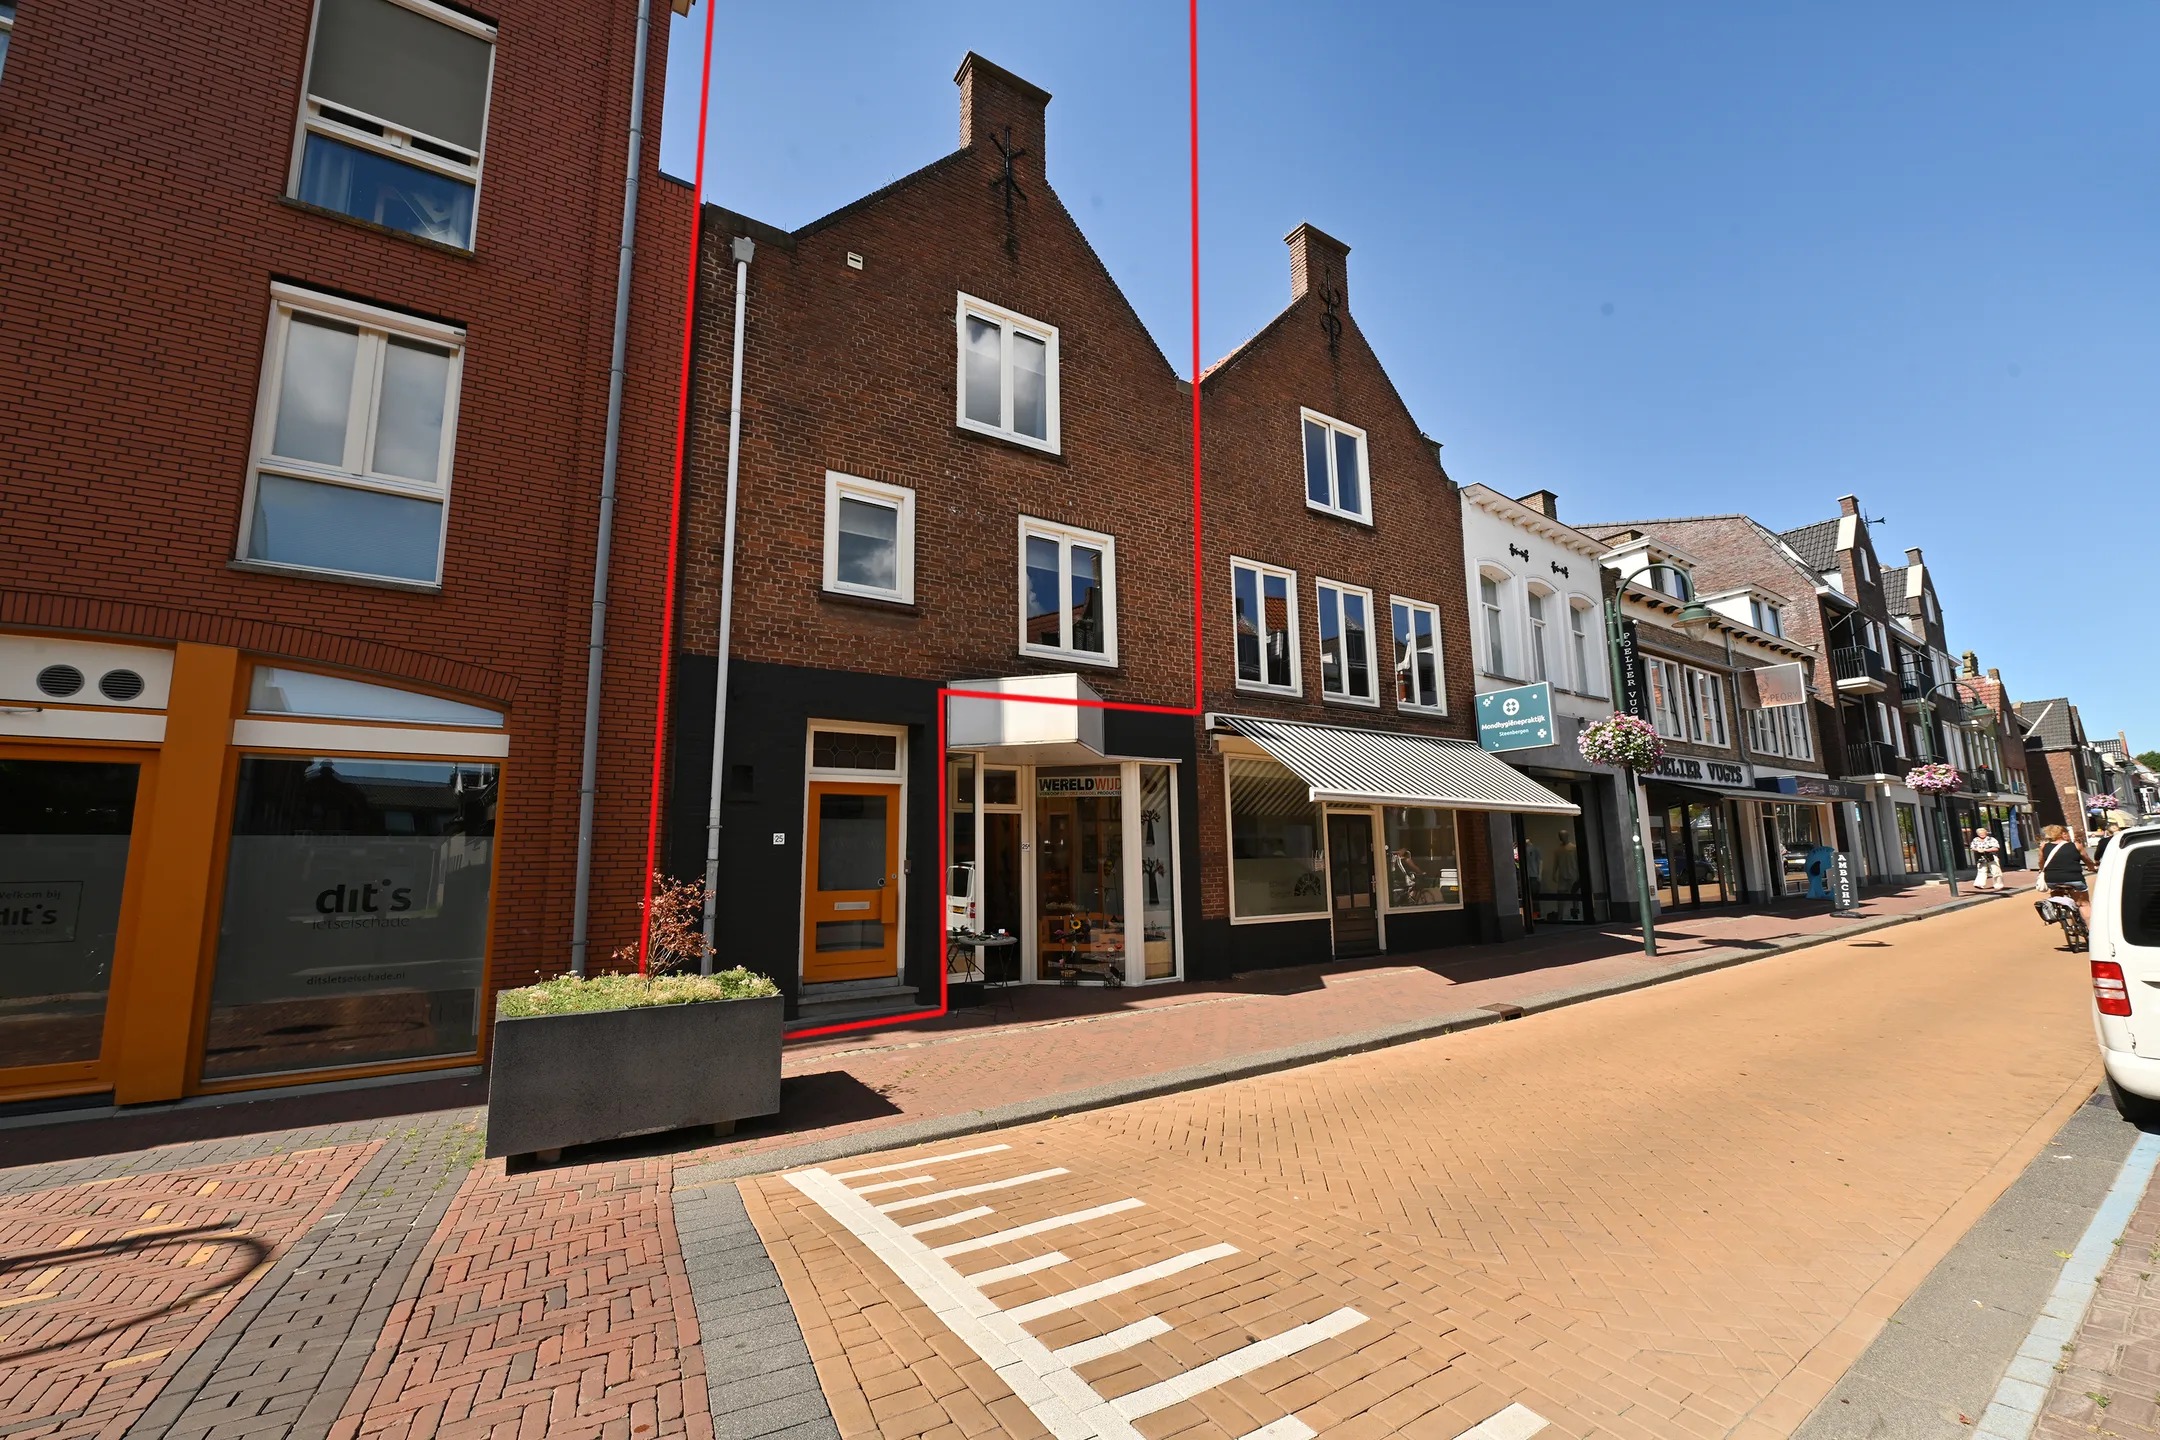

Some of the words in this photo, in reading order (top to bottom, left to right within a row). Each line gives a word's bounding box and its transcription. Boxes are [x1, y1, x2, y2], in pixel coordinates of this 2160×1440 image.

[1623, 632, 1636, 687] POELIER
[1628, 691, 1639, 714] VUG
[1481, 714, 1546, 731] Mondhygiënepraktijk
[1499, 728, 1530, 737] Steenbergen
[1654, 756, 1703, 780] OELIER
[1707, 762, 1743, 784] VUGTS
[775, 834, 784, 843] 25
[1837, 854, 1851, 906] AMBACHT
